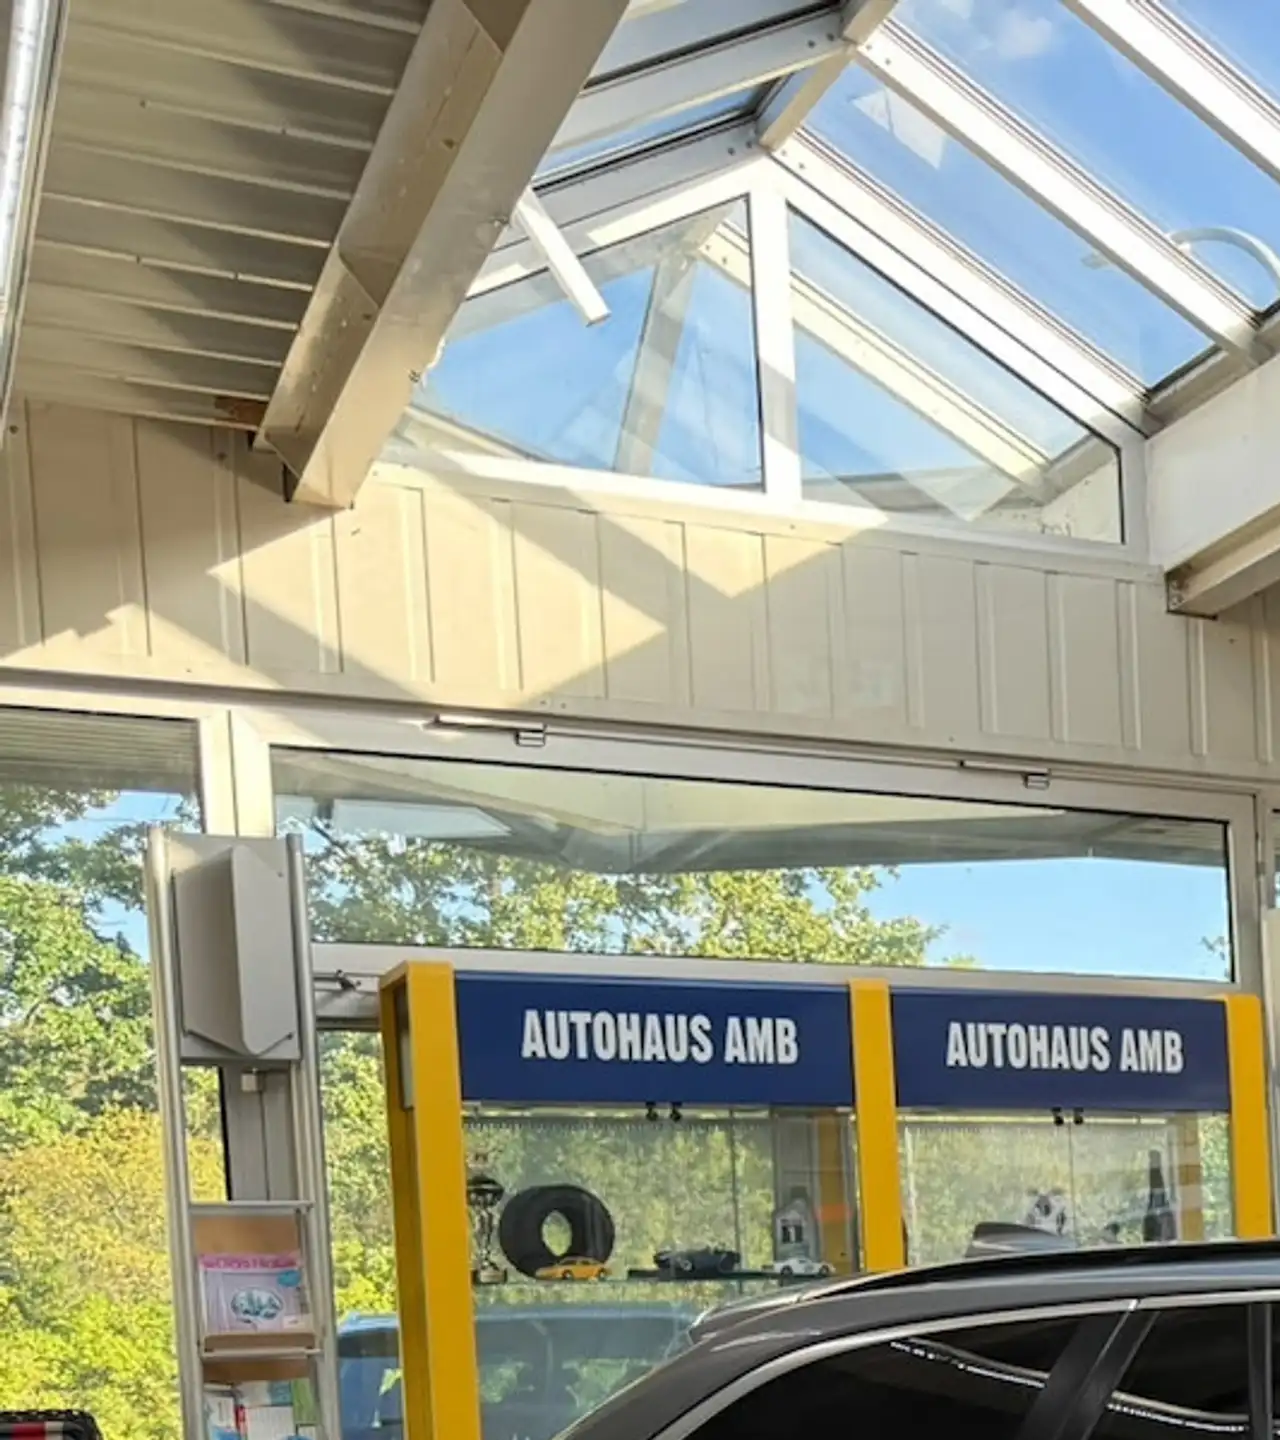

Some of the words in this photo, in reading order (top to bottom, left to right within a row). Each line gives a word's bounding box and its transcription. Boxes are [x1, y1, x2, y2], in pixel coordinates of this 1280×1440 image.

[522, 1010, 712, 1062] AUTOHAUS
[725, 1017, 797, 1063] AMB
[947, 1022, 1110, 1071] AUTOHAUS
[1120, 1029, 1183, 1073] AMB
